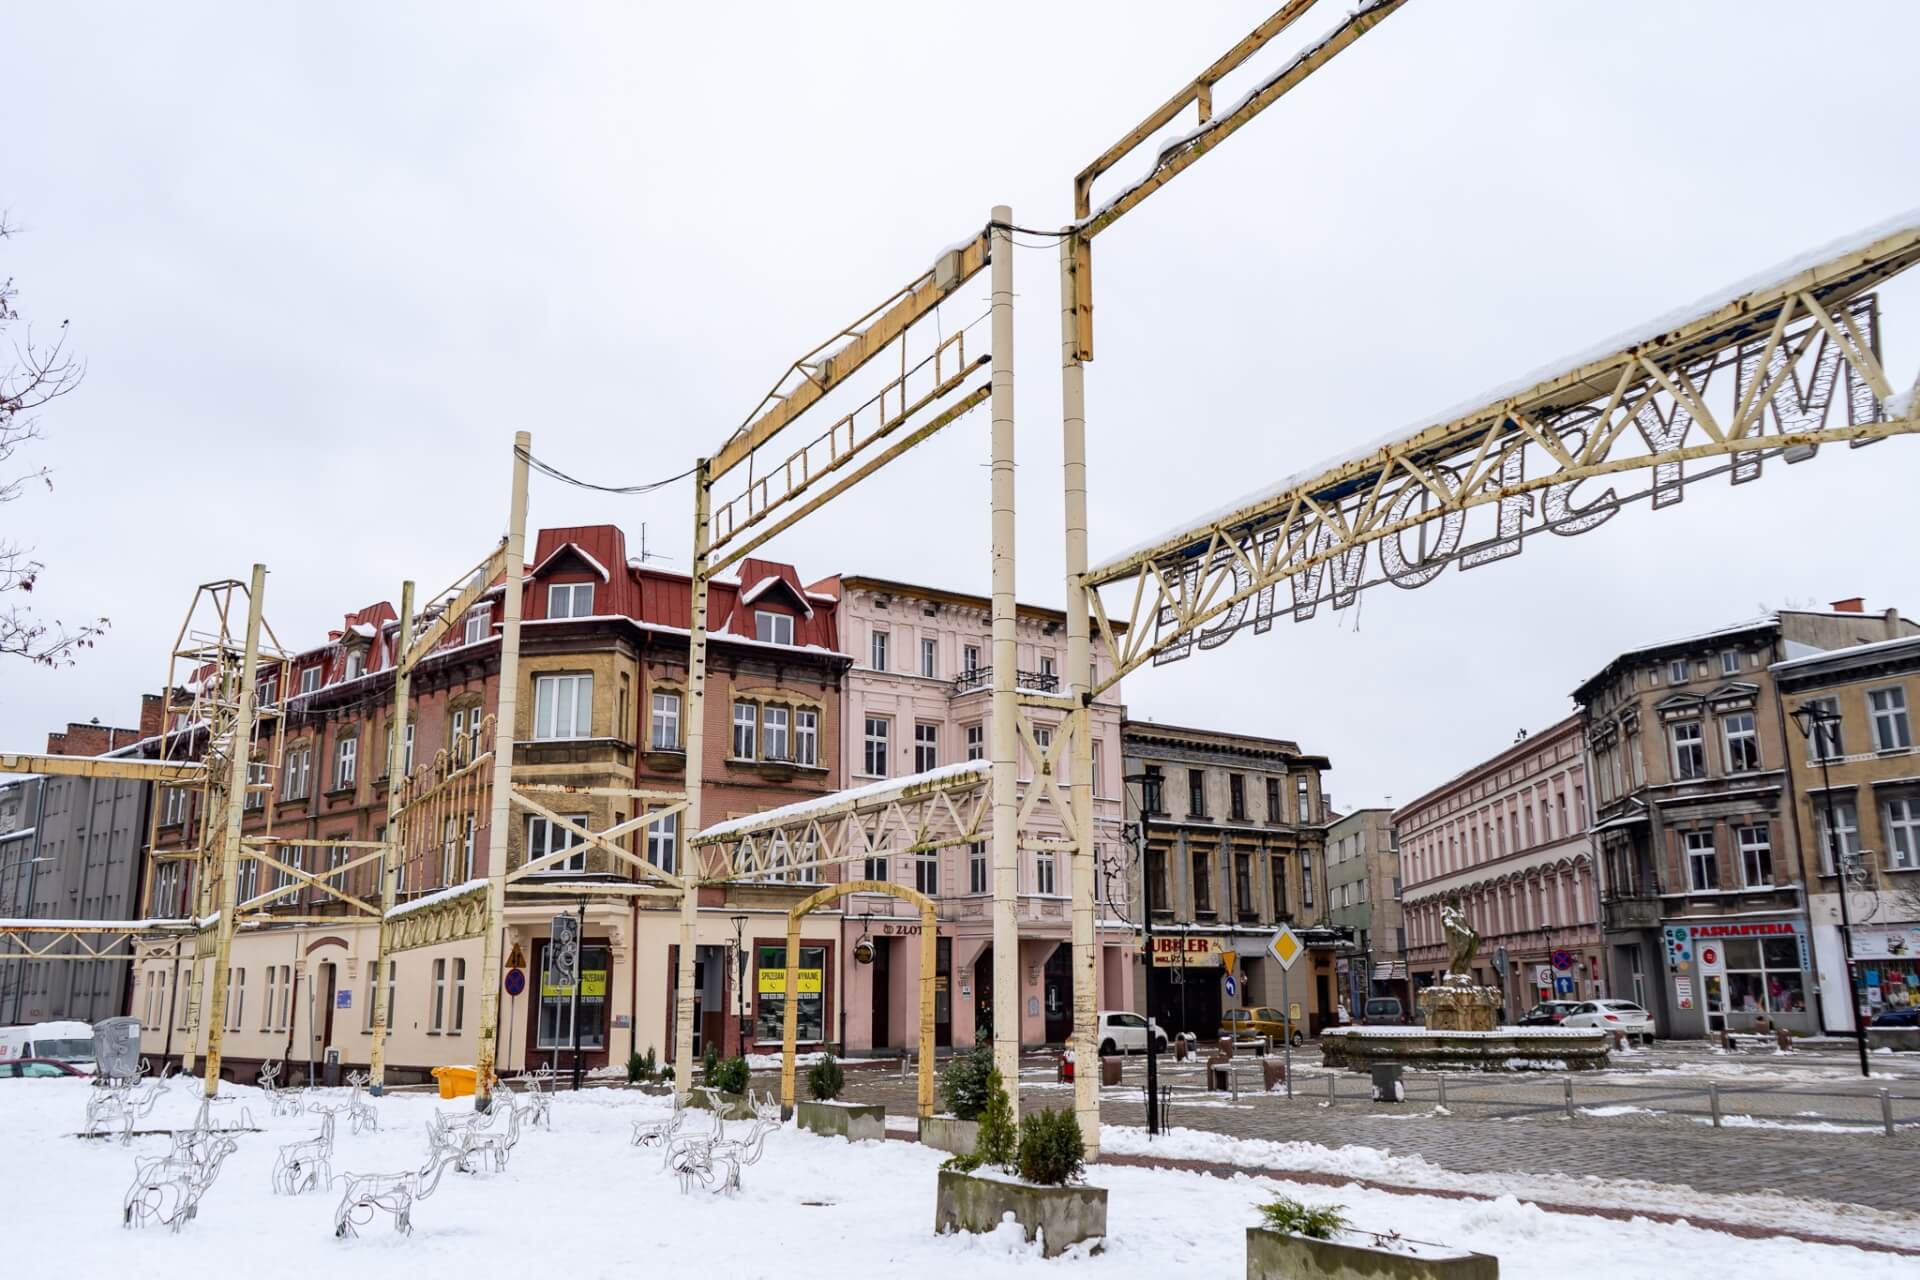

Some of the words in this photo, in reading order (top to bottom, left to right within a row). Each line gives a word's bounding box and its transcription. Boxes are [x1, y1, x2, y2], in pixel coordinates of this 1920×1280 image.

[896, 925, 942, 936] ZŁOTK
[1690, 922, 1794, 938] PASMANTERIA
[1666, 929, 1678, 973] GUZIK
